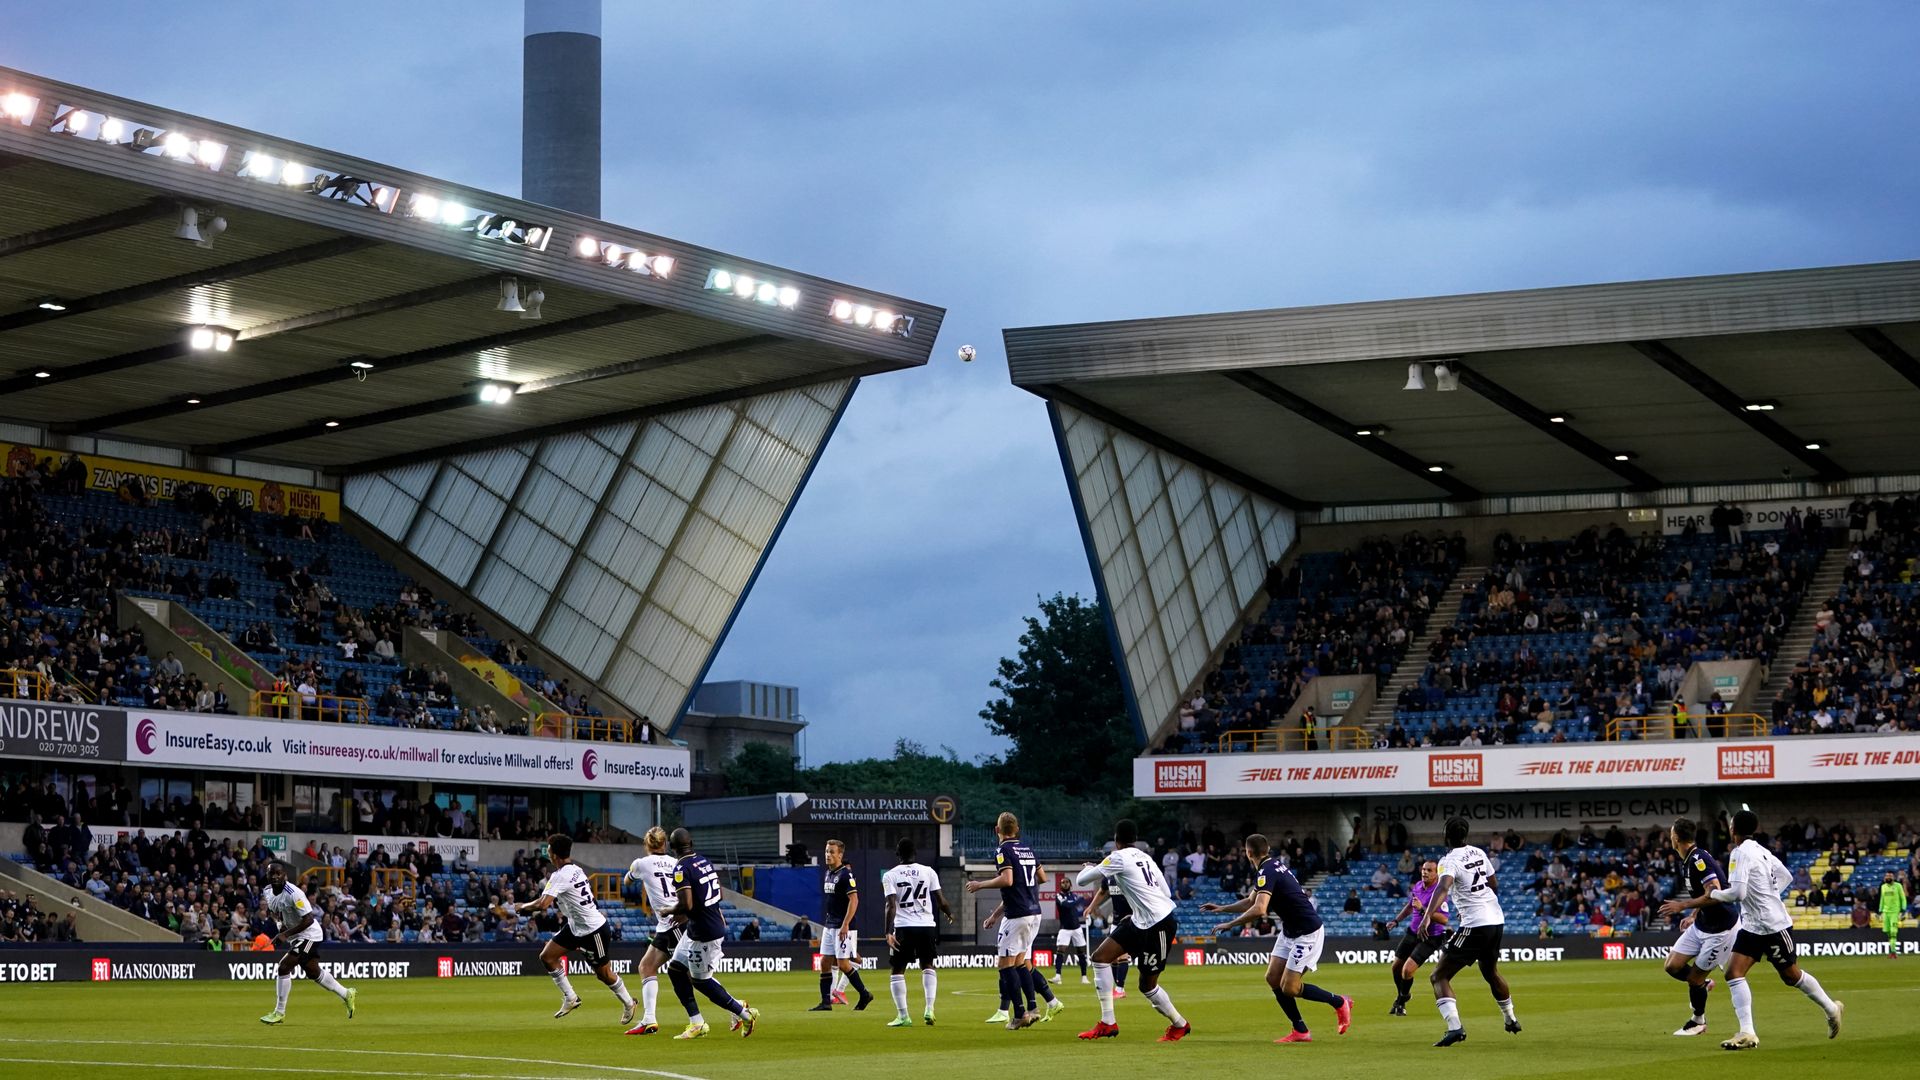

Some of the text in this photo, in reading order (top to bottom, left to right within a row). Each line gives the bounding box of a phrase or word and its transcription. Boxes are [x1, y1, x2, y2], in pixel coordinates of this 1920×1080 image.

[290, 492, 320, 510] HUSKI
[39, 741, 100, 758] 020 7700 3025
[166, 730, 272, 756] InsureEasy.co.uk
[282, 739, 574, 770] Visit insureeasy.co.uk/millwall for exclusive Millwall offers!
[1721, 750, 1770, 766] HUSKI
[1817, 752, 1858, 767] FUEL
[1864, 752, 1890, 765] THE
[604, 759, 684, 780] InsureEasy.co.uk
[1158, 766, 1202, 780] HUSKI
[1243, 766, 1398, 782] FUEL THE ADVENTURE!
[1432, 758, 1478, 774] HUSKI
[1522, 758, 1686, 776] FUEL THE ADVENTURE!
[1722, 766, 1770, 776] CHOCOLATE
[1158, 780, 1202, 789] CHOCOLATE
[1432, 774, 1478, 783] CHOCOLATE
[810, 798, 928, 810] TRISTRAM PARKER
[1373, 798, 1690, 822] SHOW RACISM THE RED CARD
[810, 811, 929, 822] www.tristramparker.co.uk
[262, 838, 276, 846] EXIT
[896, 880, 927, 908] 24
[960, 955, 982, 968] PLACE
[984, 955, 994, 968] TO
[1336, 951, 1378, 964] YOUR
[1512, 948, 1534, 962] TO
[1536, 948, 1564, 961] BET
[8, 964, 28, 981] TO
[31, 964, 56, 981] BET
[112, 963, 196, 980] MANSIONBET
[228, 963, 264, 980] YOUR
[334, 962, 370, 979] PLACE
[371, 962, 388, 978] TO
[389, 962, 410, 978] BET
[454, 961, 522, 976] MANSIONBET
[734, 958, 762, 972] PLACE
[763, 958, 776, 972] TO
[776, 958, 792, 972] BET
